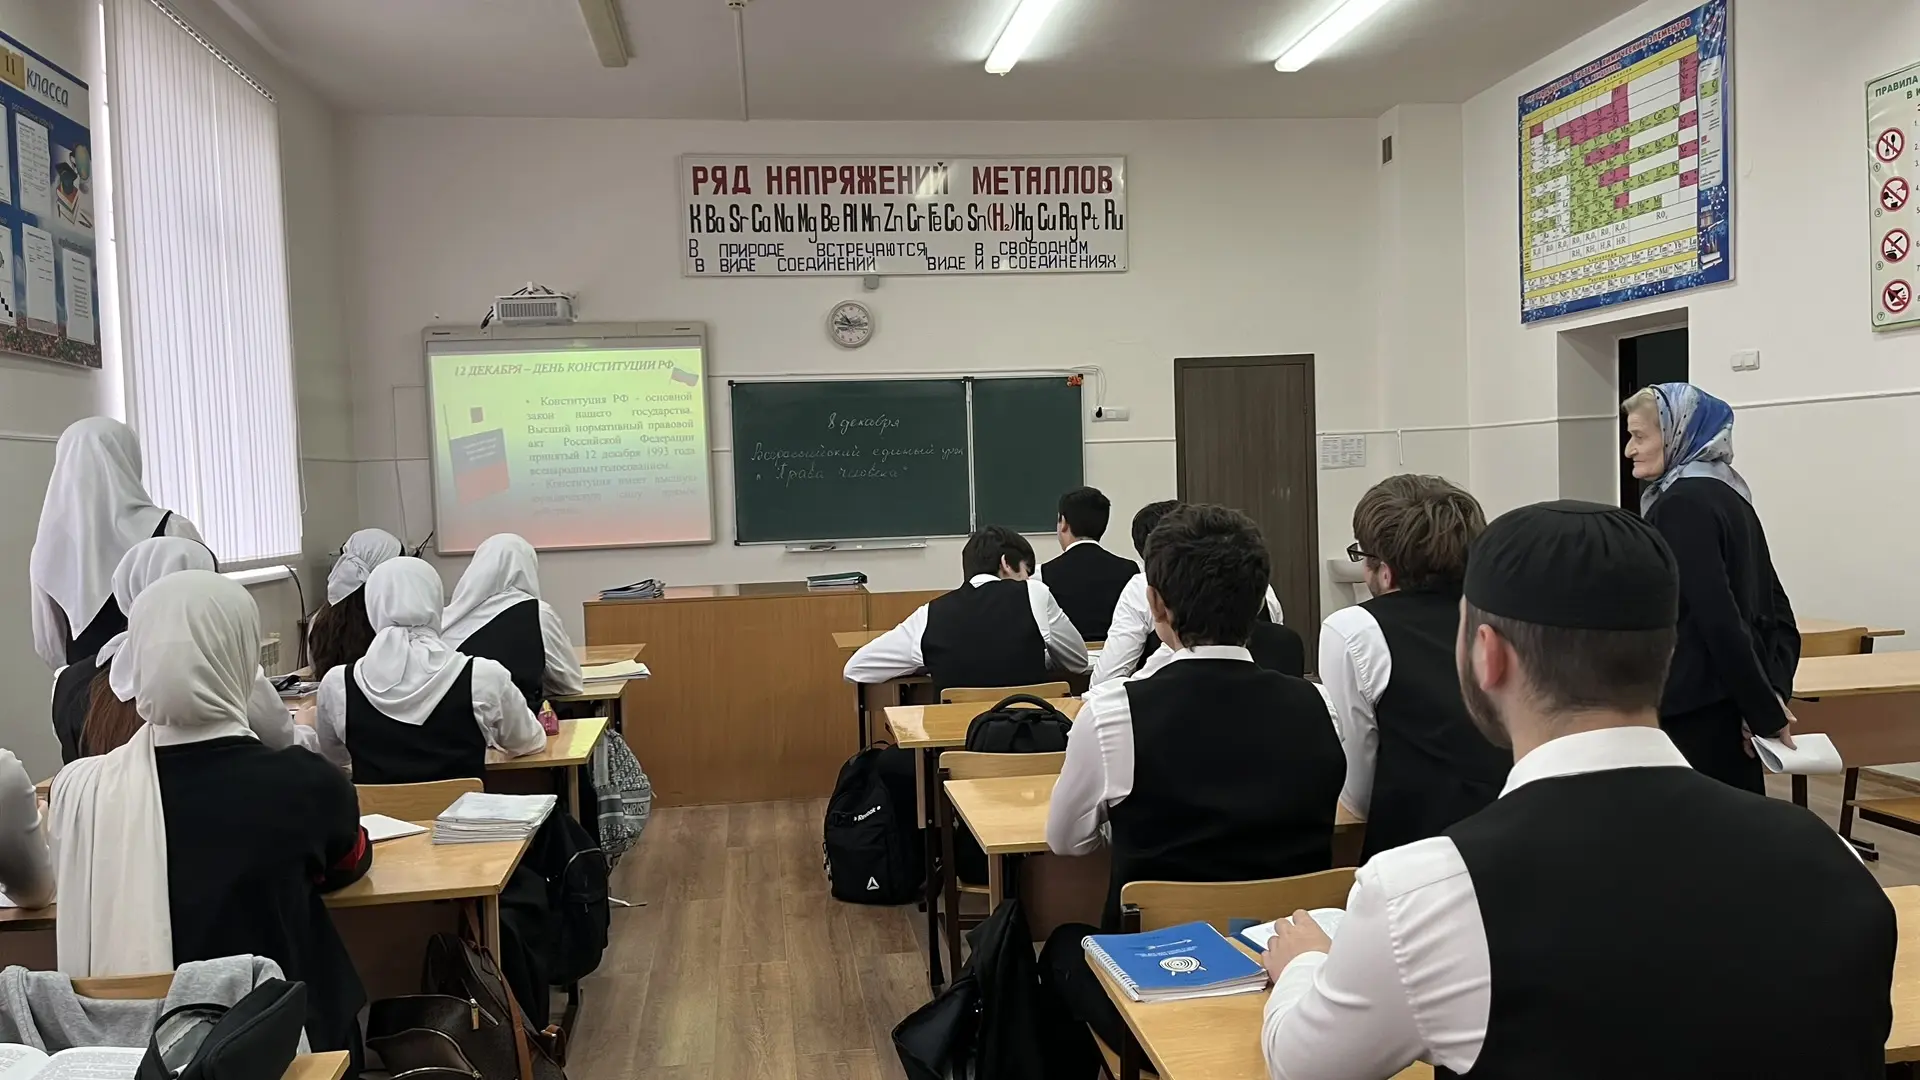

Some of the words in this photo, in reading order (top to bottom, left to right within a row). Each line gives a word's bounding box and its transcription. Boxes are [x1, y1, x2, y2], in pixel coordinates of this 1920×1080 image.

[27, 68, 69, 108] класса
[1875, 75, 1918, 97] ПРАВИЛА
[692, 166, 751, 195] РЯД
[766, 162, 948, 195] НАПРЯЖЕНИЙ
[972, 165, 1113, 195] МЕТАЛЛОВ
[689, 239, 699, 257] В
[719, 243, 784, 257] ПРИРОДЕ
[975, 243, 983, 255] В
[999, 241, 1088, 255] СВОБОДНОМ
[695, 258, 704, 273] В
[720, 258, 756, 273] ВИДЕ
[777, 255, 876, 272] СОЕДИНЕНИЙ
[927, 256, 965, 270] ВИДЕ
[975, 256, 984, 269] И
[991, 256, 1000, 269] В
[455, 366, 466, 376] 12
[468, 364, 523, 377] ДЕКАБРЯ
[533, 363, 564, 375] ДЕНЬ
[567, 360, 656, 373] КОНСТИТУЦИИ
[658, 360, 674, 370] РФ
[540, 396, 606, 408] Конституция
[613, 394, 629, 404] РФ
[645, 392, 692, 402] основной
[526, 412, 555, 420] закон
[576, 410, 612, 419] нашего
[527, 424, 571, 435] Высший
[576, 421, 643, 433] нормативный
[648, 419, 694, 431] правовой
[840, 413, 900, 435] декабря
[563, 436, 621, 447] Российской
[640, 434, 695, 445] Федерации
[529, 452, 579, 463] принятый
[585, 450, 596, 459] 12
[602, 449, 641, 459] декабря
[647, 447, 669, 457] 1993
[872, 443, 934, 463] единый
